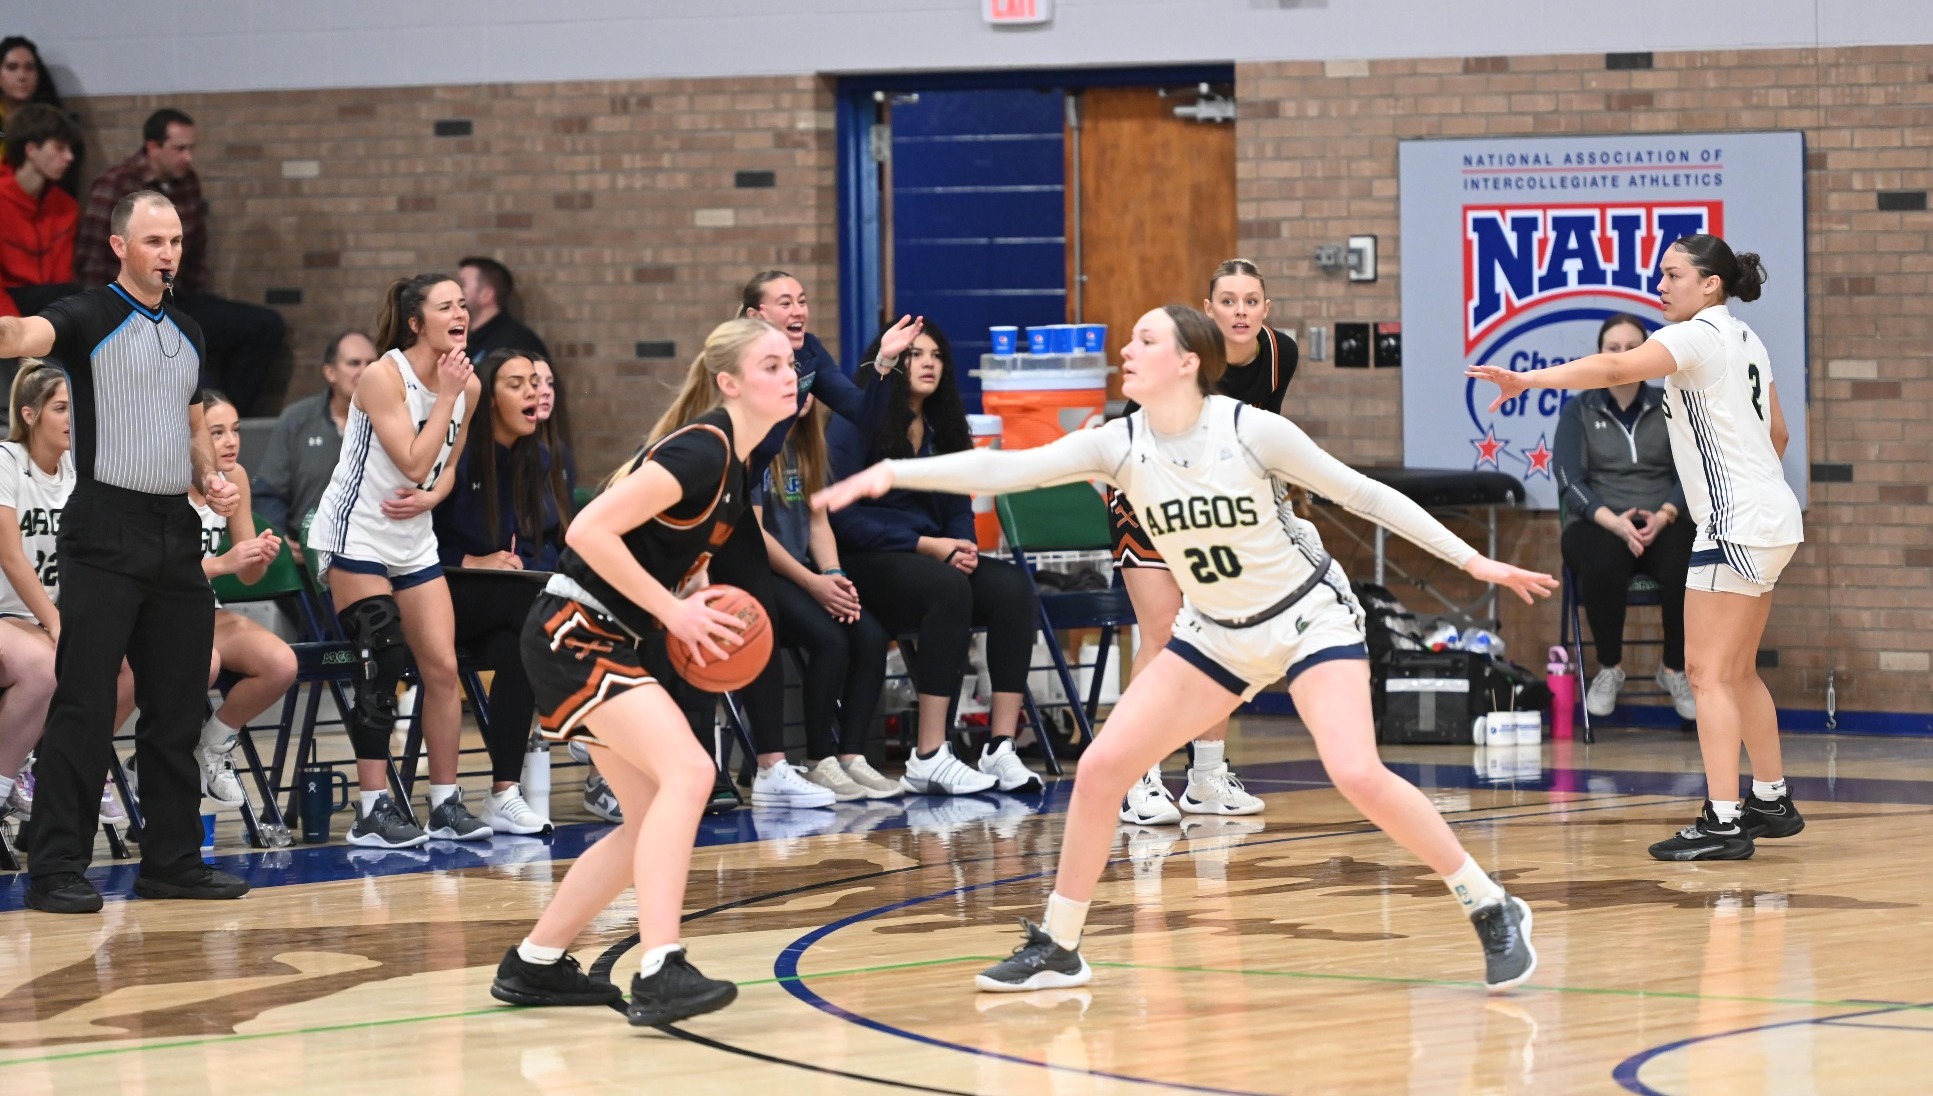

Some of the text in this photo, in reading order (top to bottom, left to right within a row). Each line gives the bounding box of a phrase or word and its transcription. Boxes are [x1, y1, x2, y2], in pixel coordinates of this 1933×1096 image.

[1463, 149, 1723, 166] NATIONAL ASSOCIATION OF
[1463, 172, 1724, 190] INTERCOLLEGIATE ATHLETICS
[1145, 495, 1259, 537] ARGOS
[1183, 544, 1243, 584] 20
[322, 650, 357, 665] ARGO
